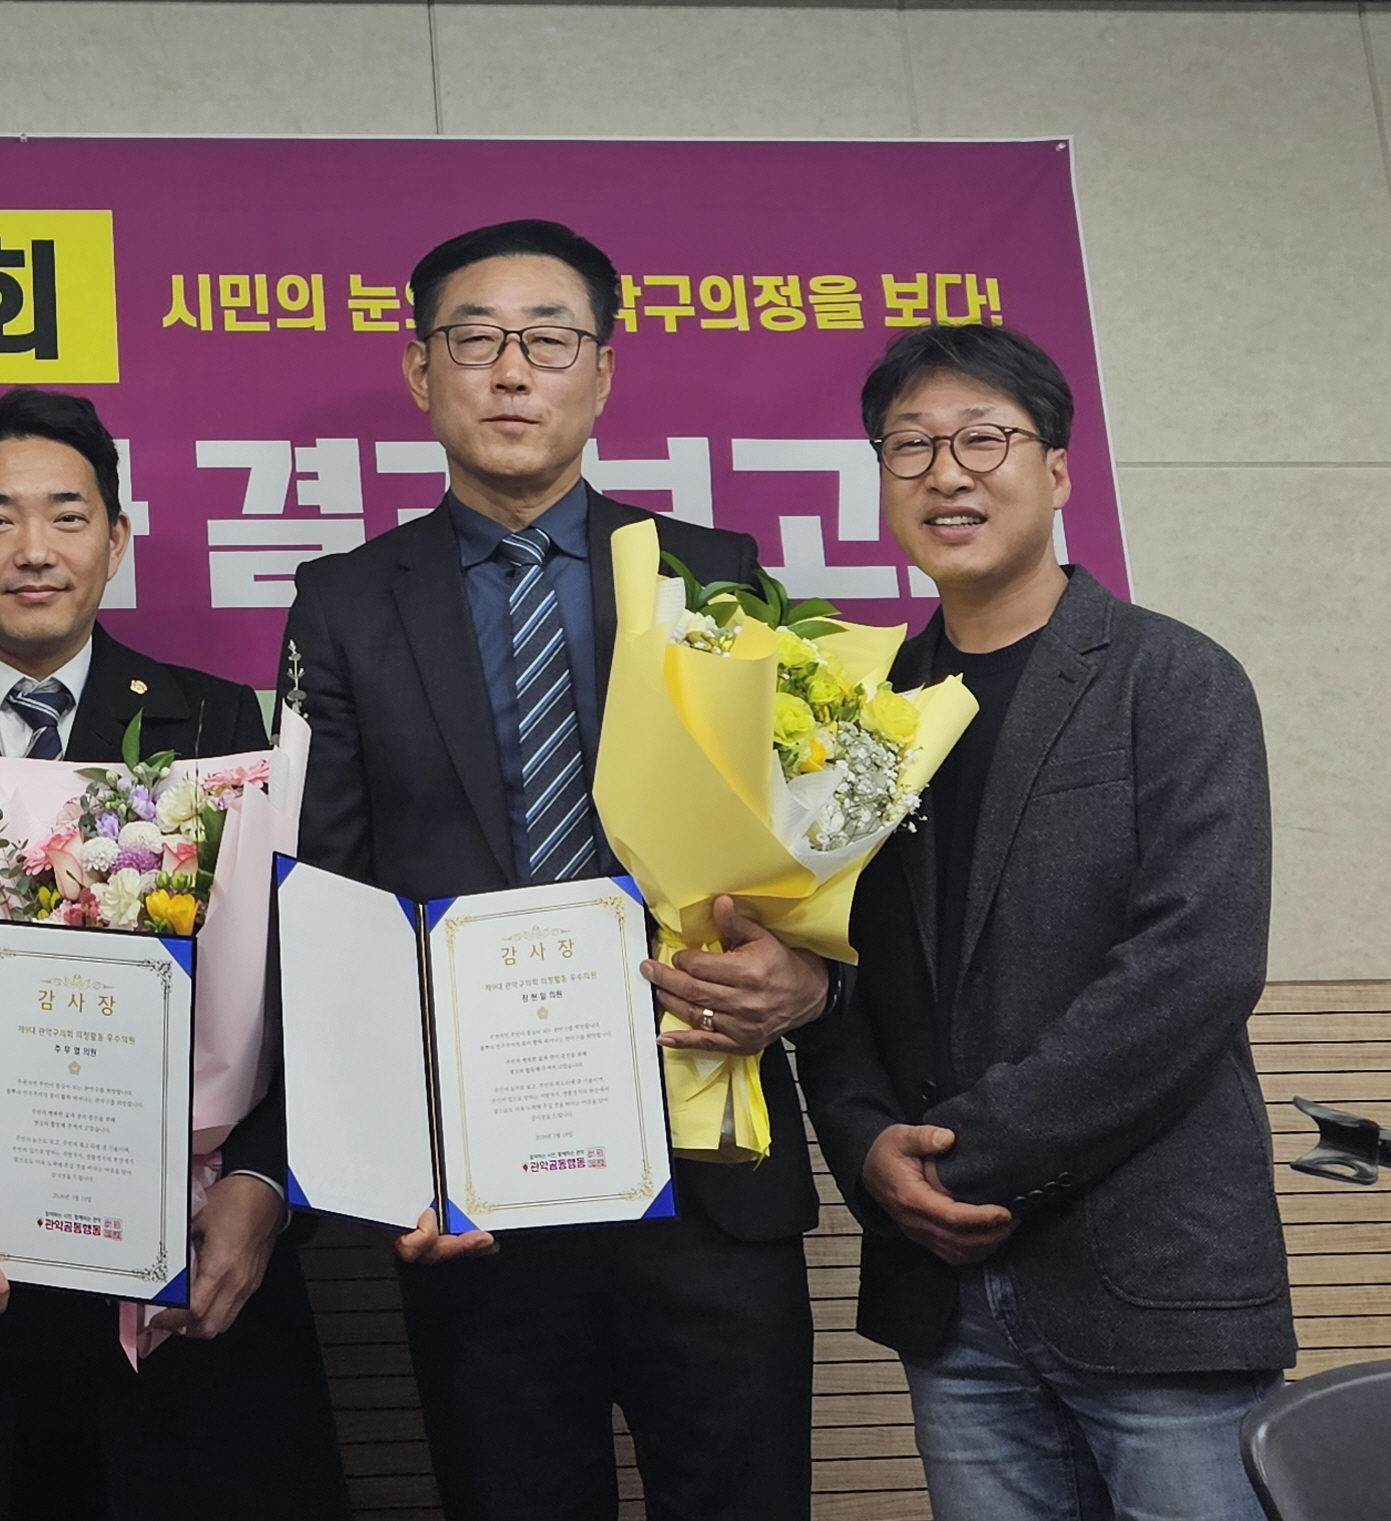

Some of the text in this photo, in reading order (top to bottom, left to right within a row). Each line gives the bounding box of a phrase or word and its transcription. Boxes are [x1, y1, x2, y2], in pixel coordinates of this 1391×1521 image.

[162, 273, 326, 332] 시민의
[881, 272, 1003, 328] 보다!
[530, 1157, 586, 1173] 관악공동행동
[45, 1219, 101, 1236] 관악공동행동
